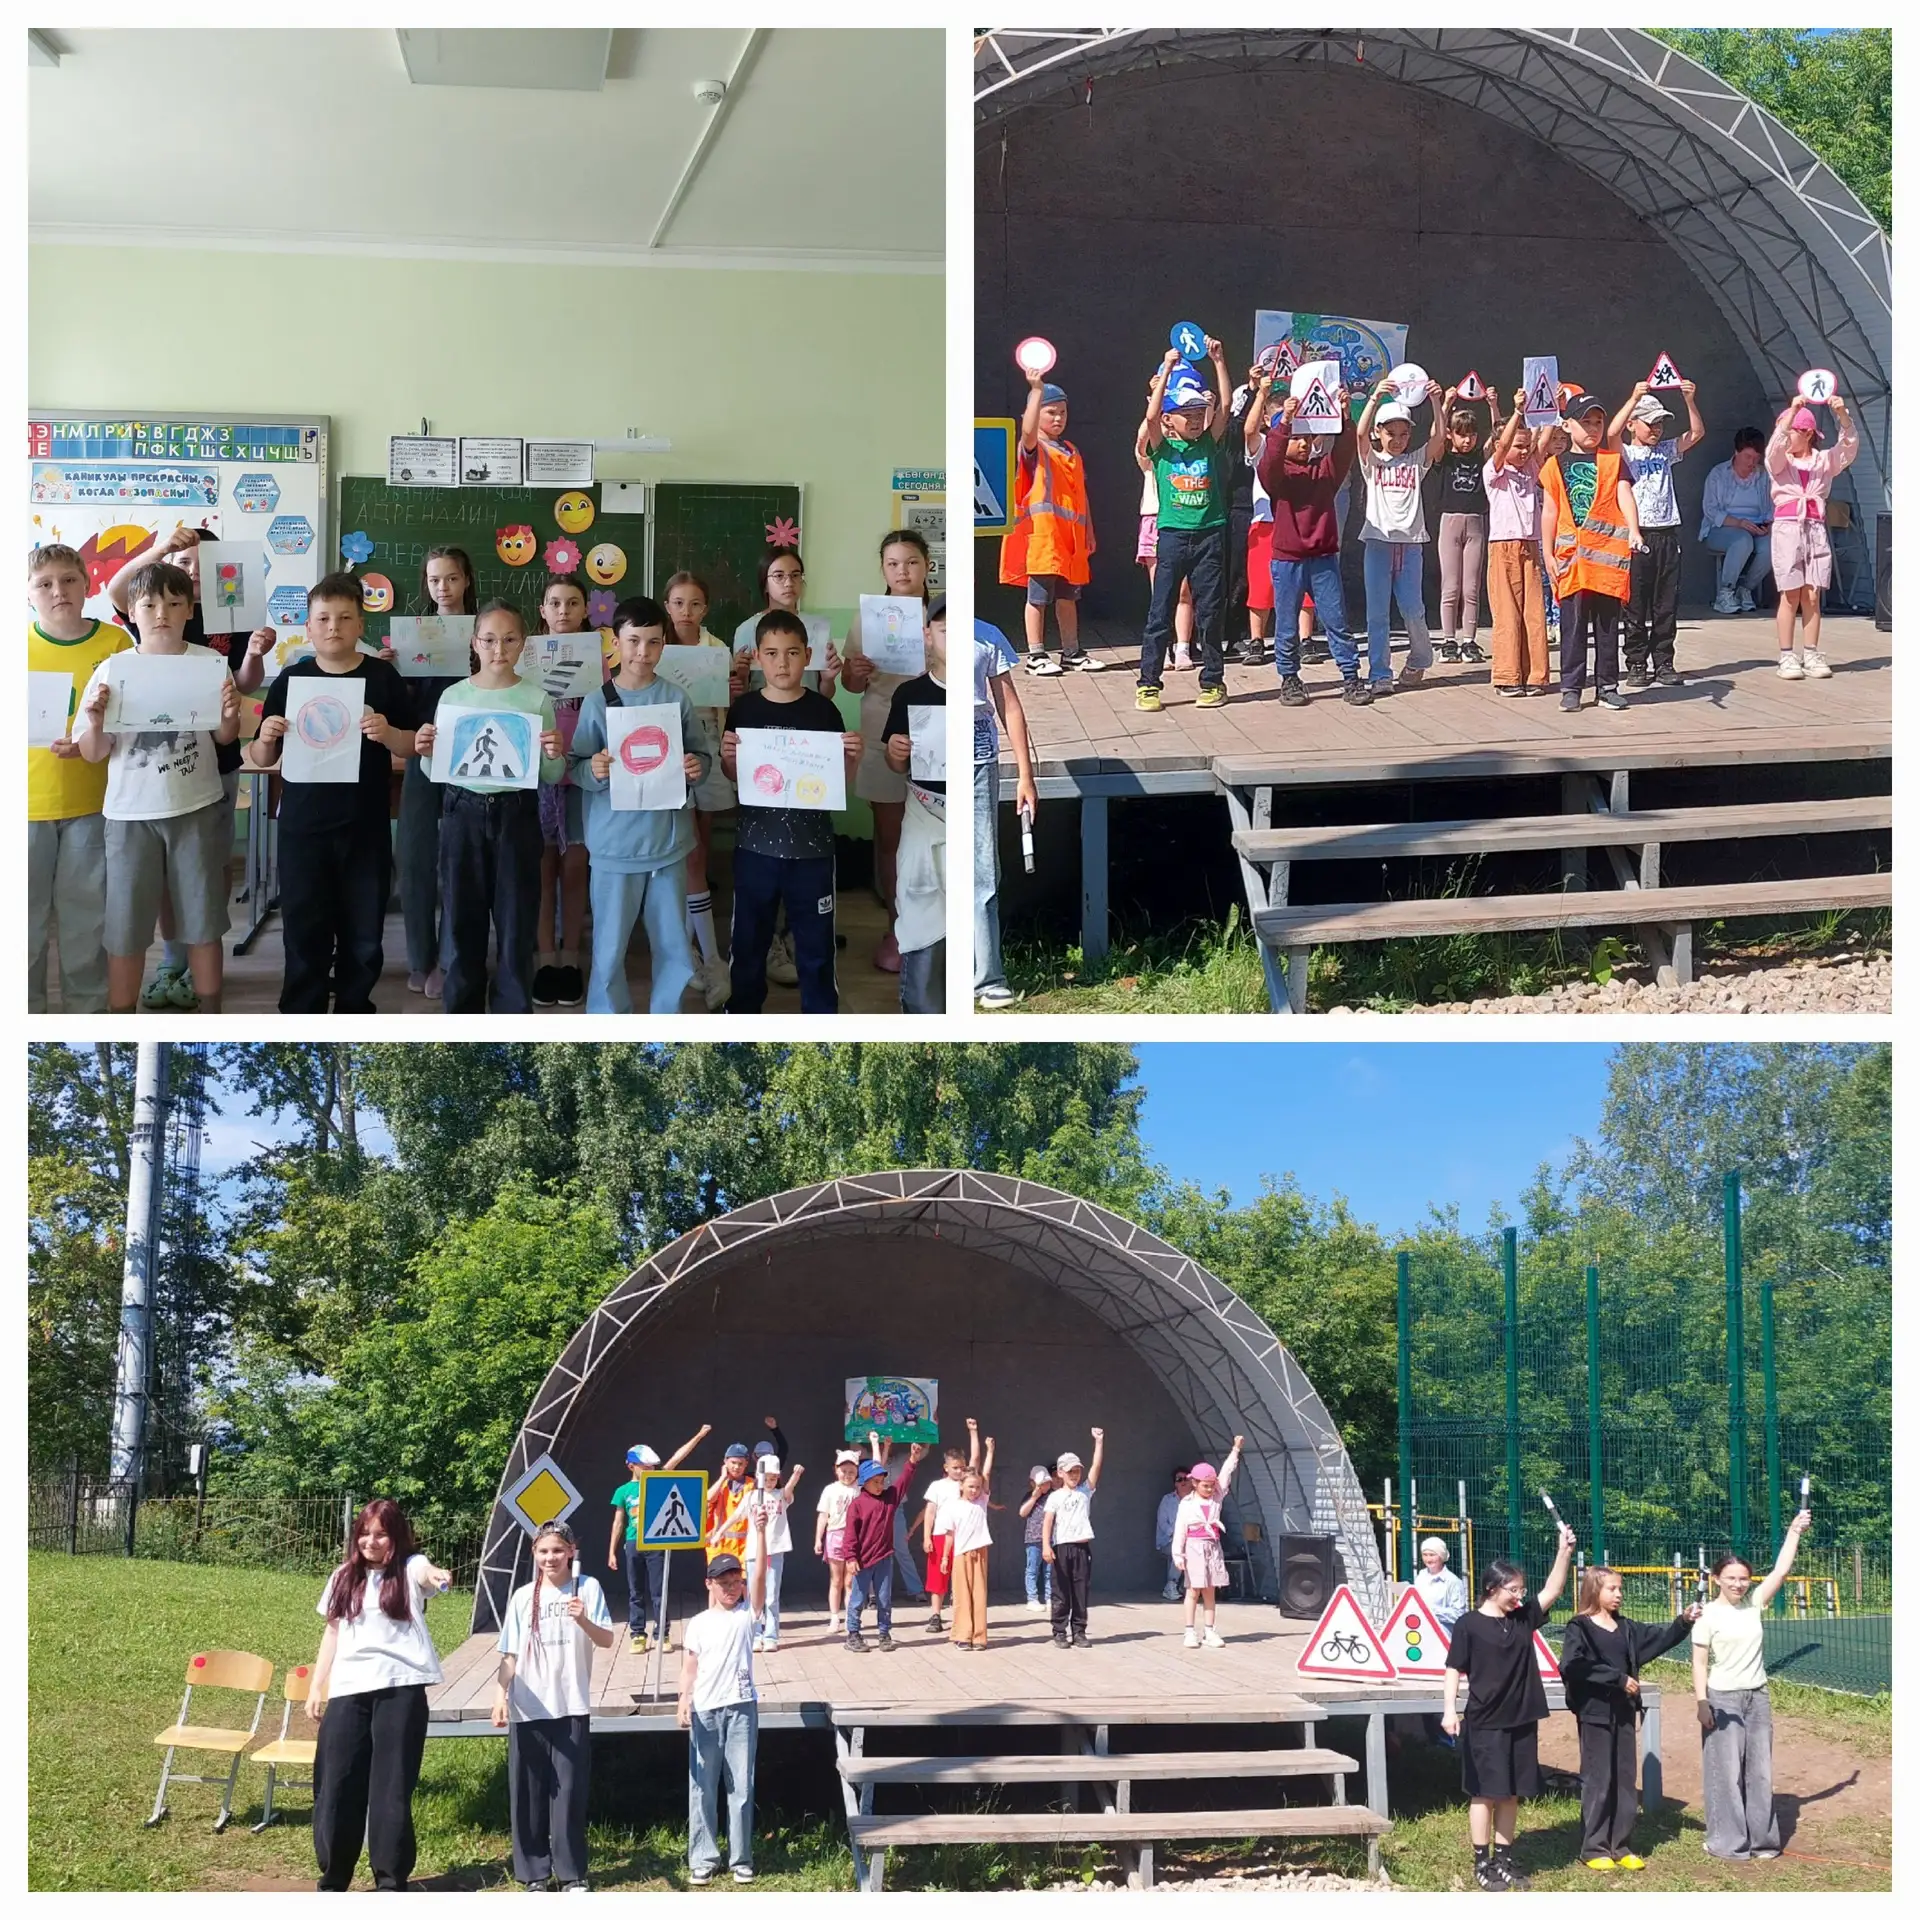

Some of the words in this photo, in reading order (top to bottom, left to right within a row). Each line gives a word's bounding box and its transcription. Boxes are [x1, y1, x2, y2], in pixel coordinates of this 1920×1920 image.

[65, 472, 127, 482] КАНИКУЛЫ
[131, 473, 201, 484] ПРЕКРАСНЫ,
[1183, 478, 1205, 489] THE
[898, 482, 941, 490] СЕГОДНЯ
[78, 488, 115, 497] КОГДА
[119, 488, 190, 498] БЕЗОПАСНЫ!
[355, 503, 498, 525] АДРЕНАЛИН
[158, 764, 170, 774] WE
[173, 755, 191, 769] NEED
[178, 762, 197, 776] TALK
